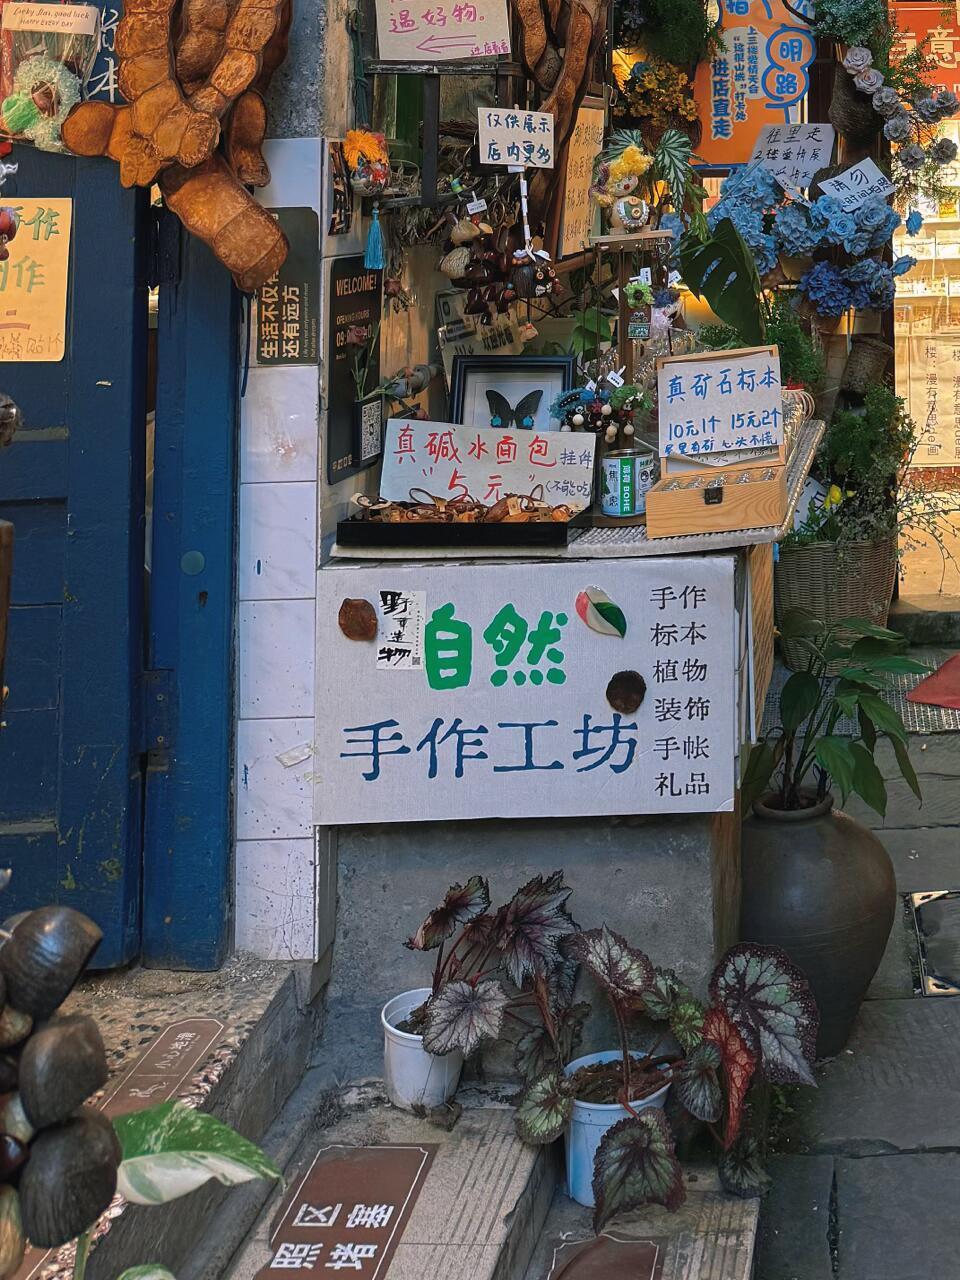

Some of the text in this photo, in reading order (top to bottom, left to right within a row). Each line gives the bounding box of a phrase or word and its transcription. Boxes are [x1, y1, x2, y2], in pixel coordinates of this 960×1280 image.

[487, 112, 551, 133] 仅供展示
[488, 139, 551, 165] 店内更多
[829, 168, 869, 192] 请勿
[336, 274, 377, 297] WELCOME!
[282, 285, 301, 358] 还有远方
[667, 365, 779, 404] 真矿石标本
[650, 584, 708, 611] 手作
[425, 601, 569, 691] 自然
[650, 621, 708, 648] 标本
[652, 658, 709, 684] 植物
[653, 696, 712, 724] 装饰
[339, 712, 639, 783] 手作工坊
[653, 771, 712, 798] 礼品
